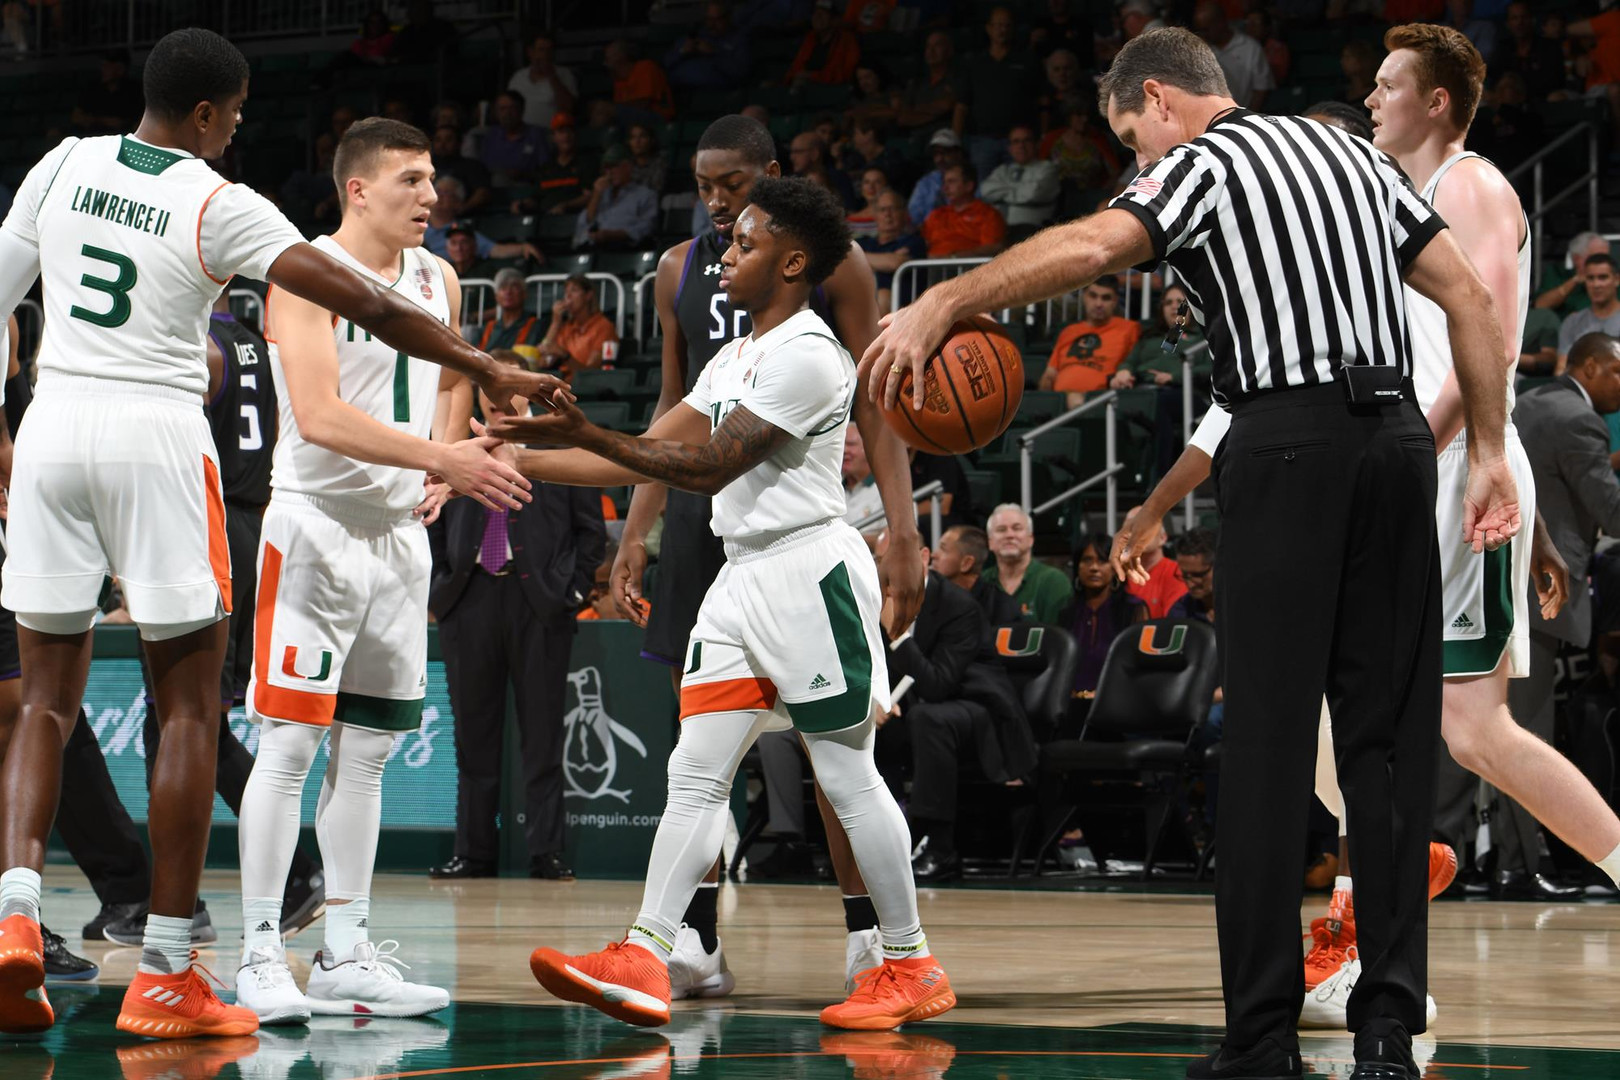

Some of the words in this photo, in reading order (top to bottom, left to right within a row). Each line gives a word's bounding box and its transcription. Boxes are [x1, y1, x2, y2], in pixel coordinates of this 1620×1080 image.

[71, 186, 156, 233] LAWRENCE
[154, 210, 171, 237] II
[70, 243, 138, 329] 3
[709, 292, 748, 340] SF
[233, 341, 258, 366] UES
[955, 344, 990, 402] PRO
[1138, 624, 1188, 655] U
[1452, 620, 1474, 628] adidas
[995, 627, 1045, 657] U
[281, 645, 333, 682] U
[809, 681, 831, 690] adidas
[516, 811, 662, 829] olpenguin.com
